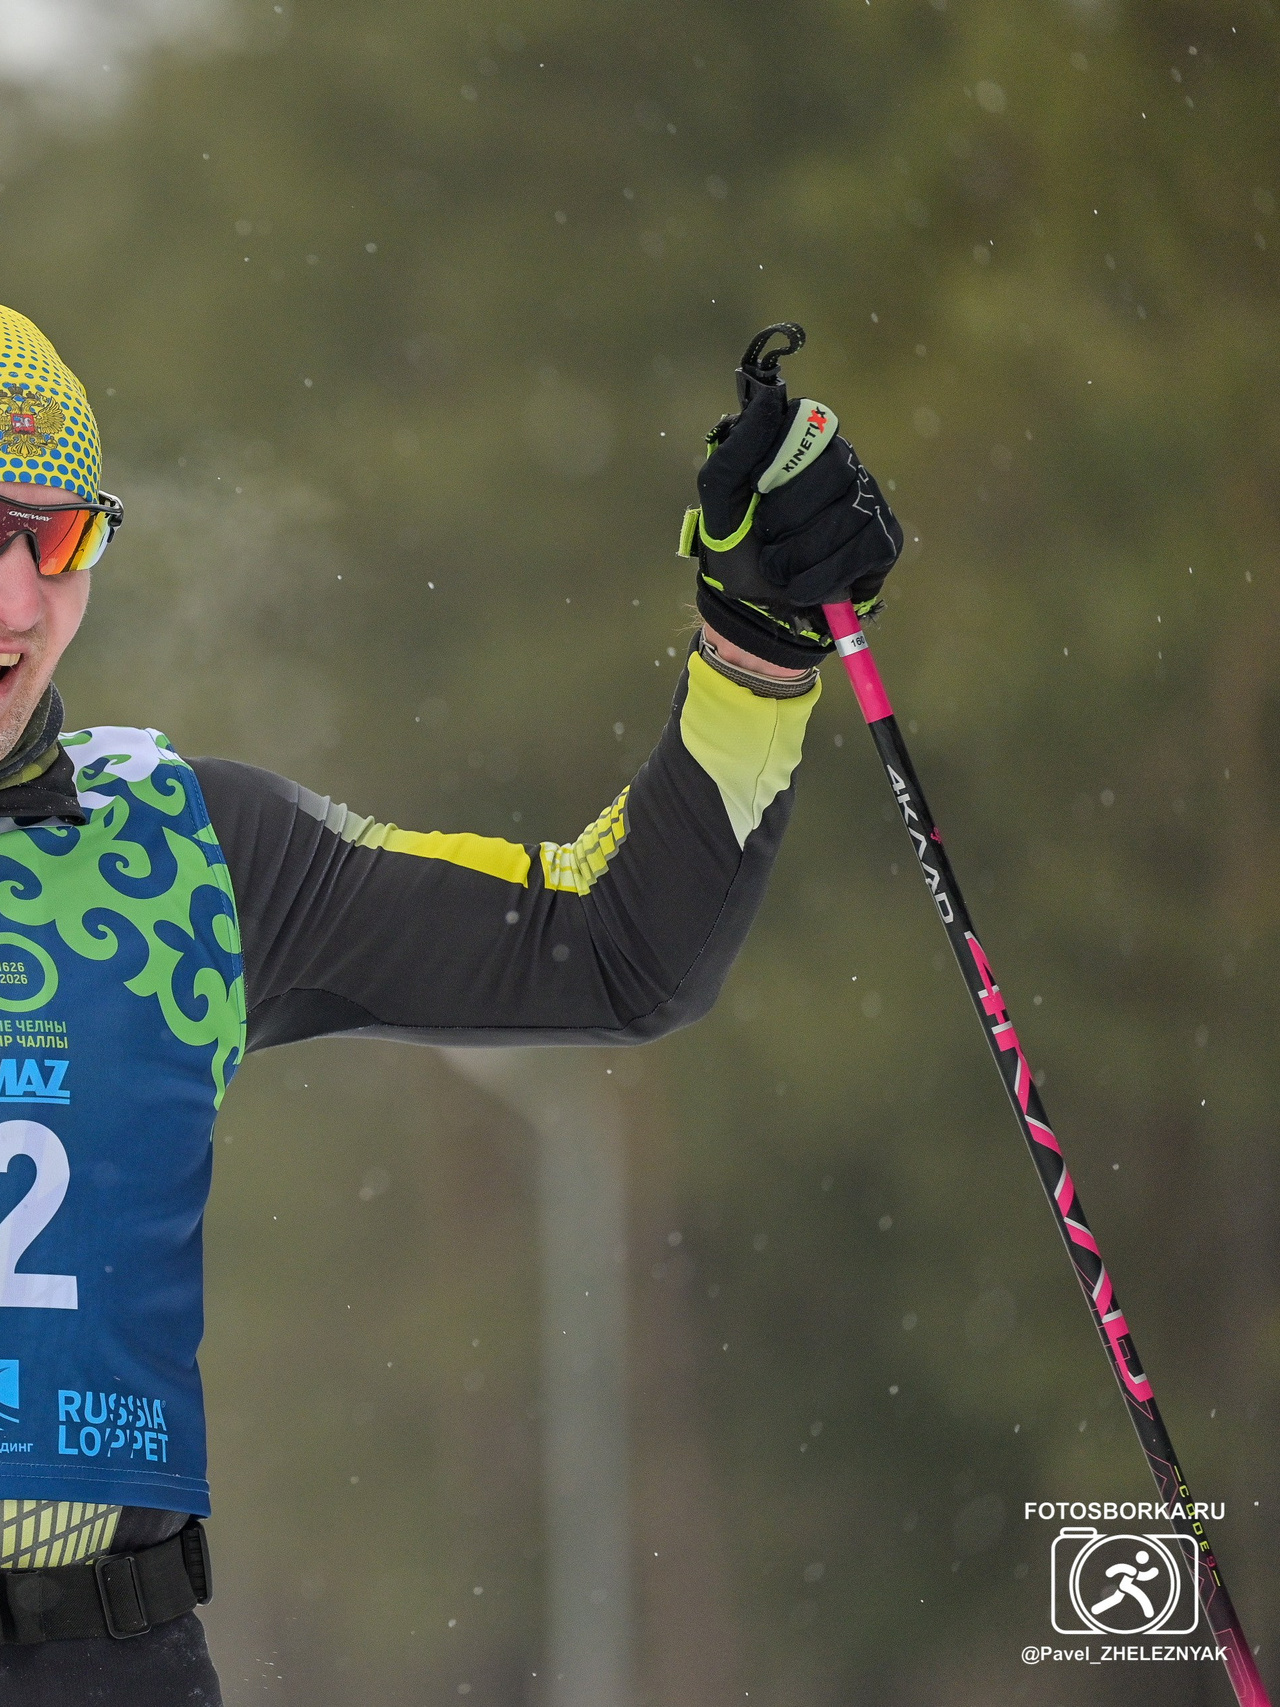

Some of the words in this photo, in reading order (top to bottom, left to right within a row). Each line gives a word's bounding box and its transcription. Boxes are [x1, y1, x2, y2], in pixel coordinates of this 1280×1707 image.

[0, 973, 28, 985] 2026
[15, 1020, 67, 1034] ЧЕЛНЫ
[16, 1035, 68, 1049] ЧАЛЛЫ
